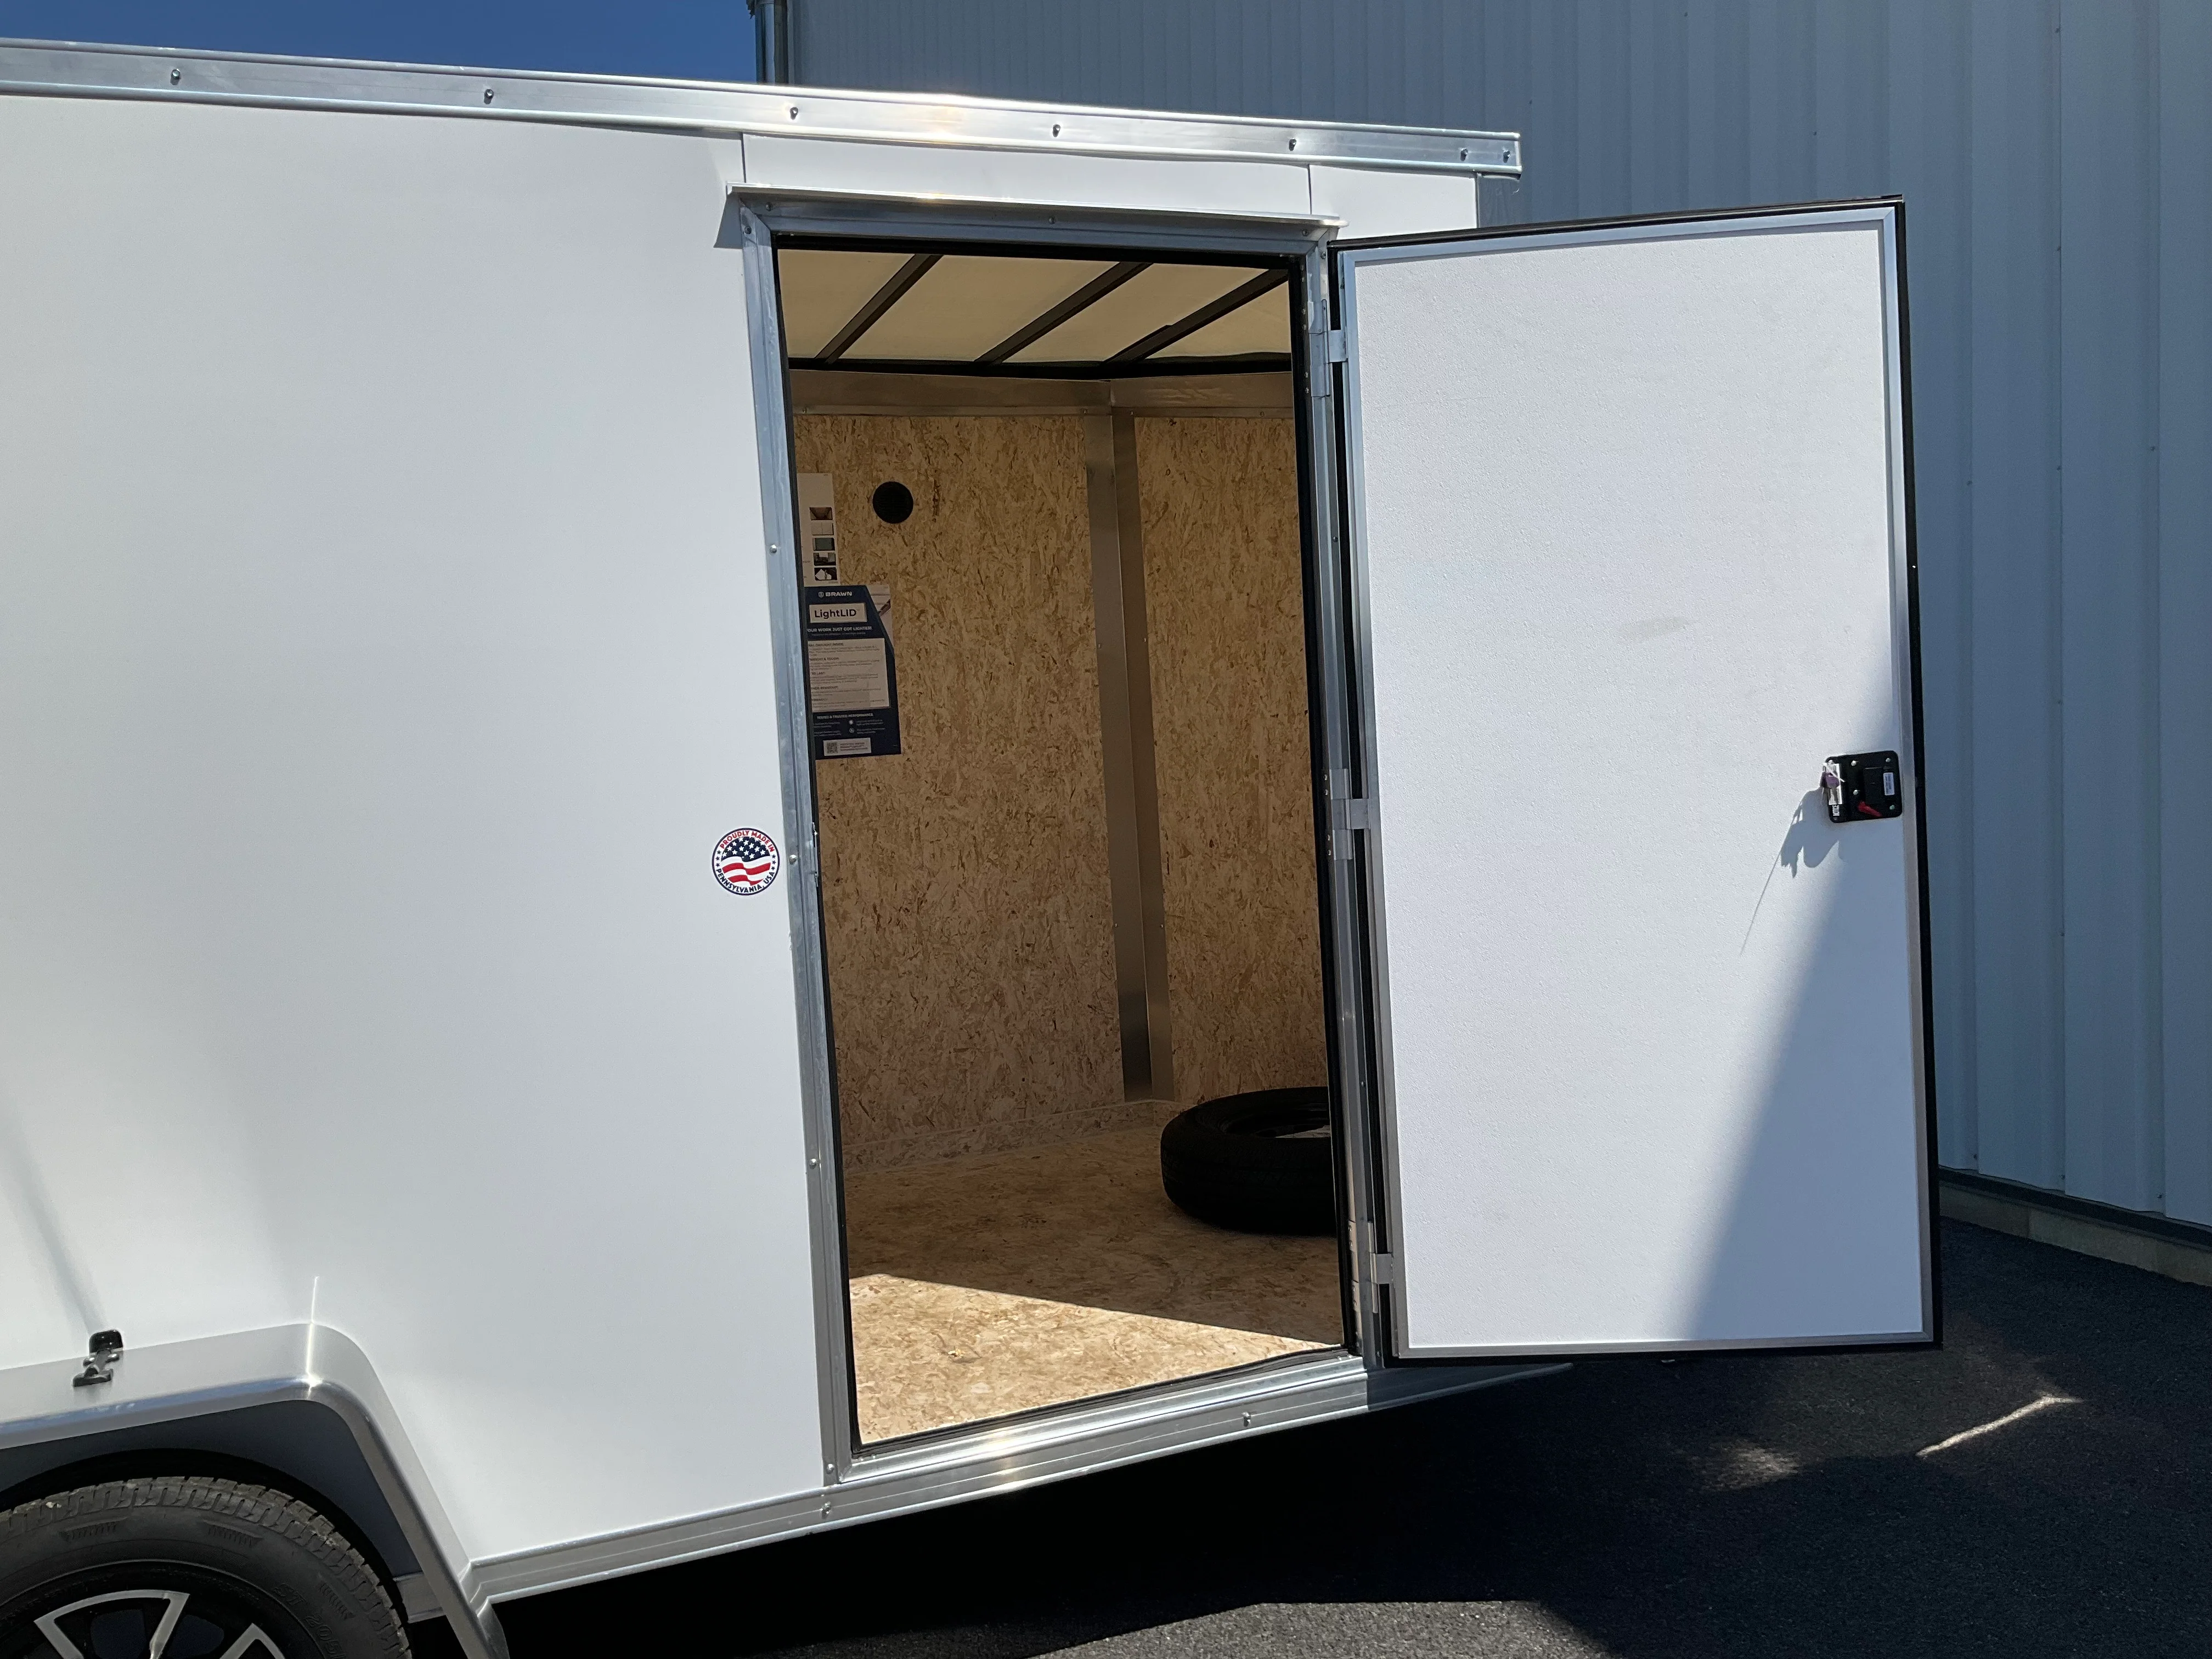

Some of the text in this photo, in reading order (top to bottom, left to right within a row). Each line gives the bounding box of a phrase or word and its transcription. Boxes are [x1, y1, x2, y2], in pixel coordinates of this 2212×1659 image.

[814, 609, 856, 619] LightLID
[720, 830, 775, 853] PROUDLY MADE IN
[715, 868, 776, 893] PENNSYLVANIA, USA
[273, 1583, 307, 1607] ST
